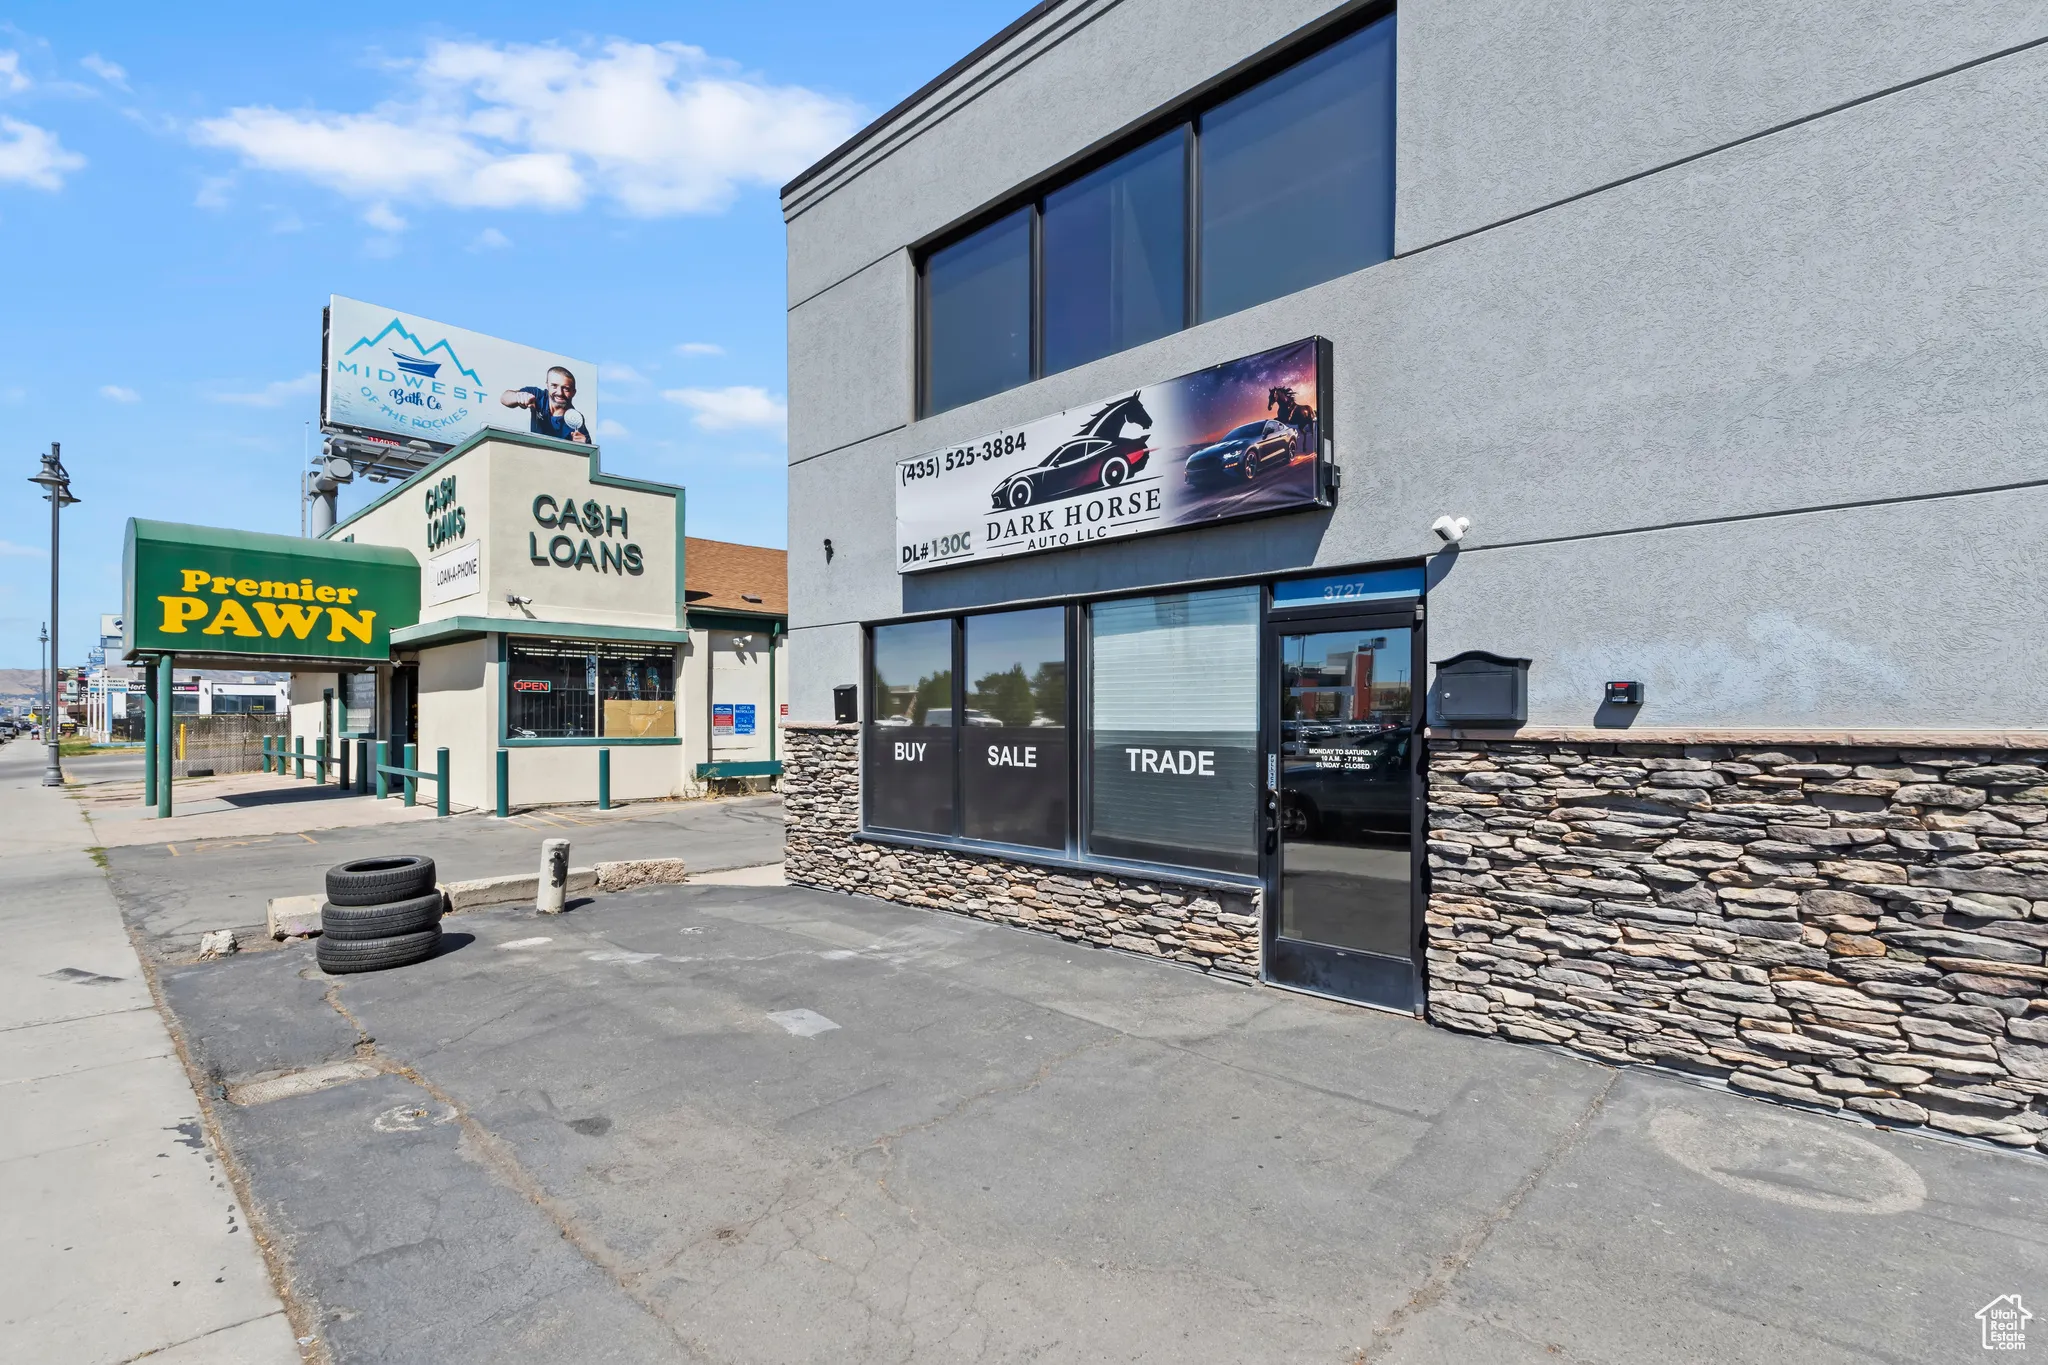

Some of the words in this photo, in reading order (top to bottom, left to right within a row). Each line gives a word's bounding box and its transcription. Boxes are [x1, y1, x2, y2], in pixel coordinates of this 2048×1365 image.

[338, 360, 488, 404] MIDWEST
[389, 388, 424, 406] Bath
[427, 395, 443, 411] Co.
[361, 386, 379, 404] OF
[380, 403, 408, 424] THE
[412, 407, 468, 429] ROCKIES
[902, 457, 940, 487] (435)
[945, 432, 1026, 471] 525-3884
[427, 506, 466, 550] LOANS
[533, 494, 628, 537] CA$H
[986, 510, 1054, 542] DARK
[1064, 488, 1161, 527] HORSE
[529, 531, 643, 573] LOANS
[1027, 532, 1069, 550] AUTO
[1077, 526, 1107, 542] LLC
[180, 569, 359, 604] Premier
[437, 558, 477, 587] LOAN-A-PHONE
[1324, 583, 1364, 600] 3727
[157, 595, 377, 644] PAWN
[514, 681, 548, 691] OPEN
[894, 742, 927, 762] BUY
[988, 745, 1037, 768] SALE
[1125, 748, 1215, 776] TRADE
